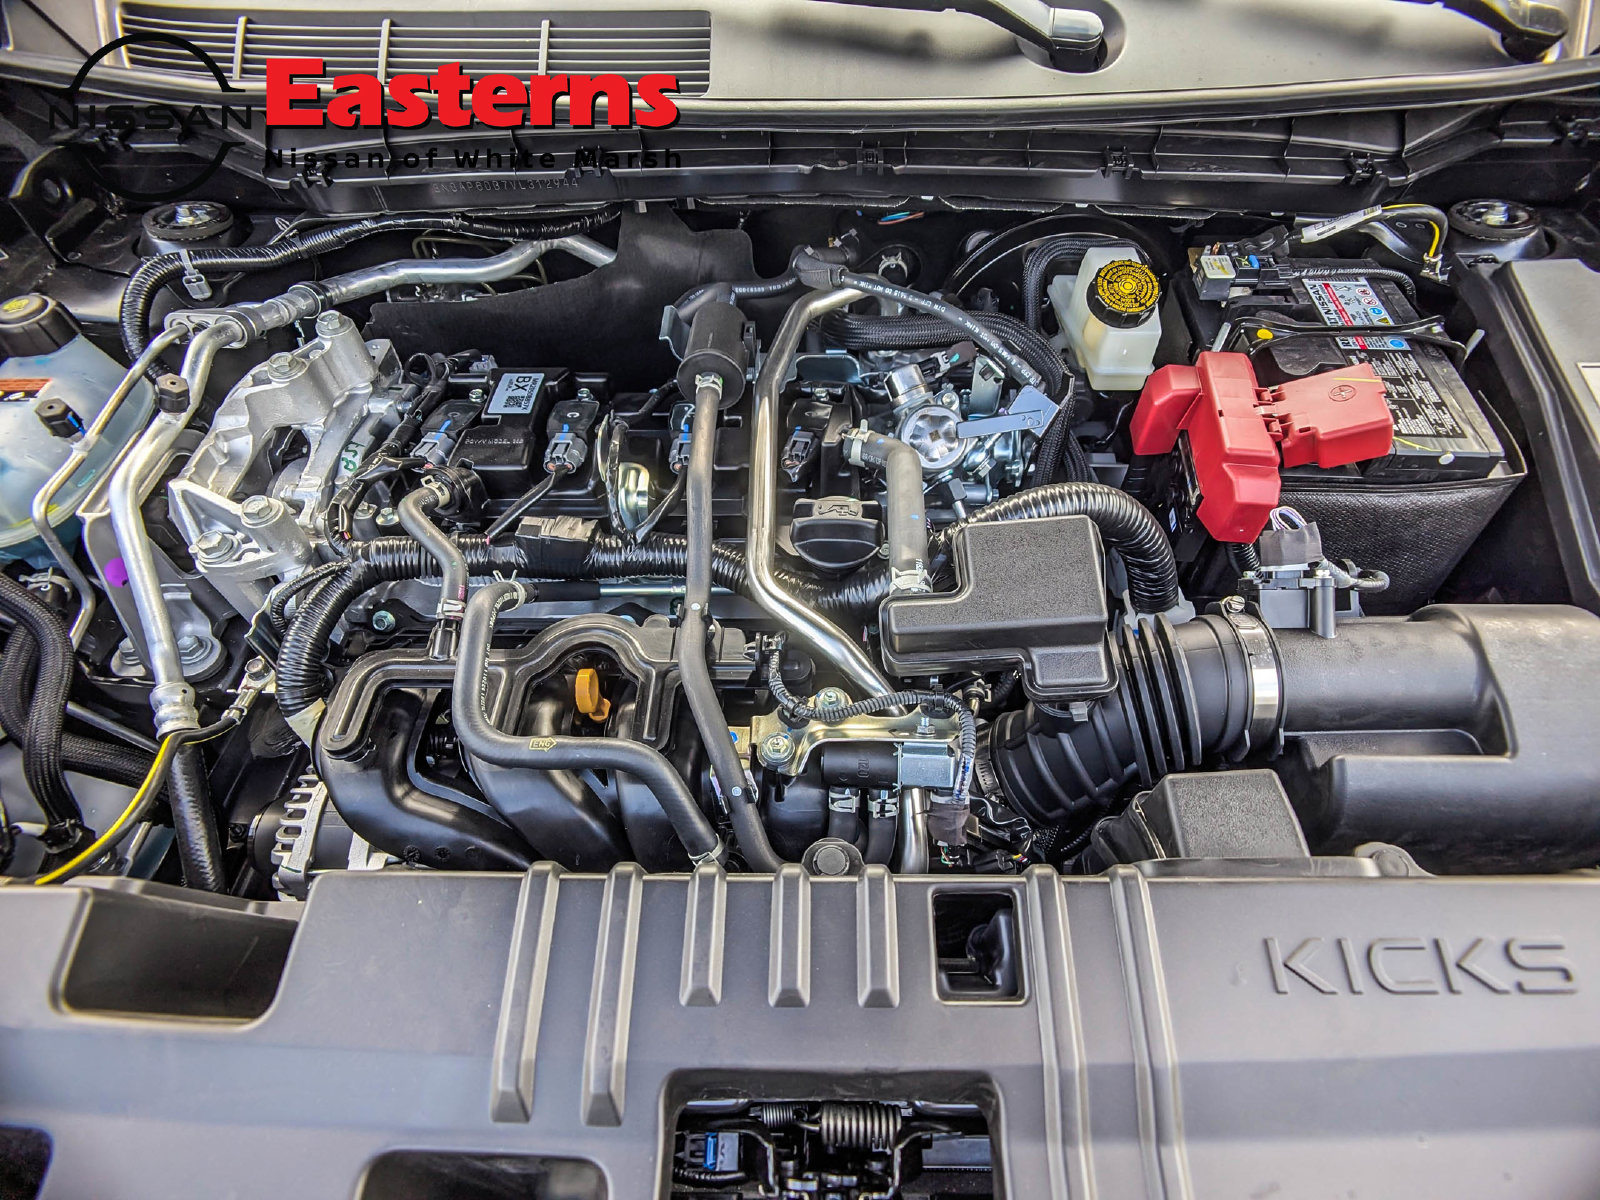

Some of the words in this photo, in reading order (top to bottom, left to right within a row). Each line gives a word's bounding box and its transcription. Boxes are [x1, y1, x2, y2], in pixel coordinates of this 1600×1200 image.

[1309, 284, 1334, 315] NISSAN
[511, 375, 533, 392] BX
[532, 739, 551, 748] ENG
[1263, 937, 1579, 995] KICKS
